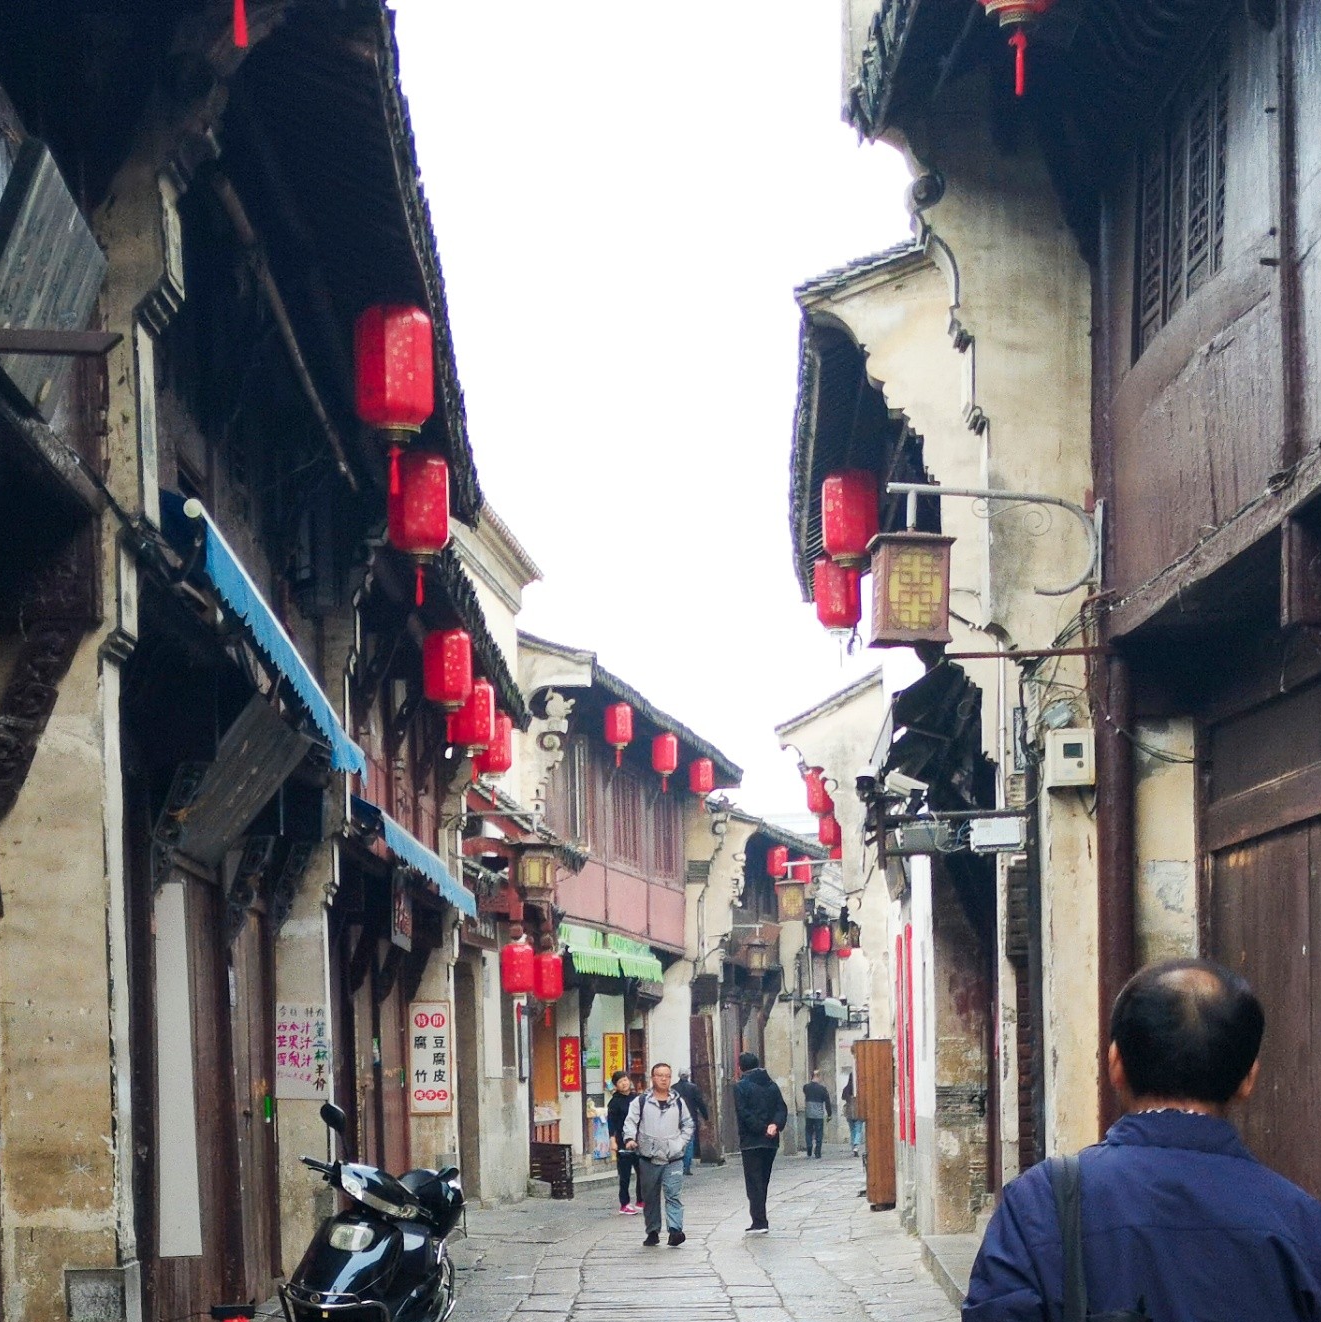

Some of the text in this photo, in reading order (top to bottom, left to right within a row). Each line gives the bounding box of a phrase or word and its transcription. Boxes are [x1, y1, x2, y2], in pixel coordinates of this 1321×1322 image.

[414, 1036, 427, 1083] 腐竹
[433, 1036, 446, 1083] 豆腐皮
